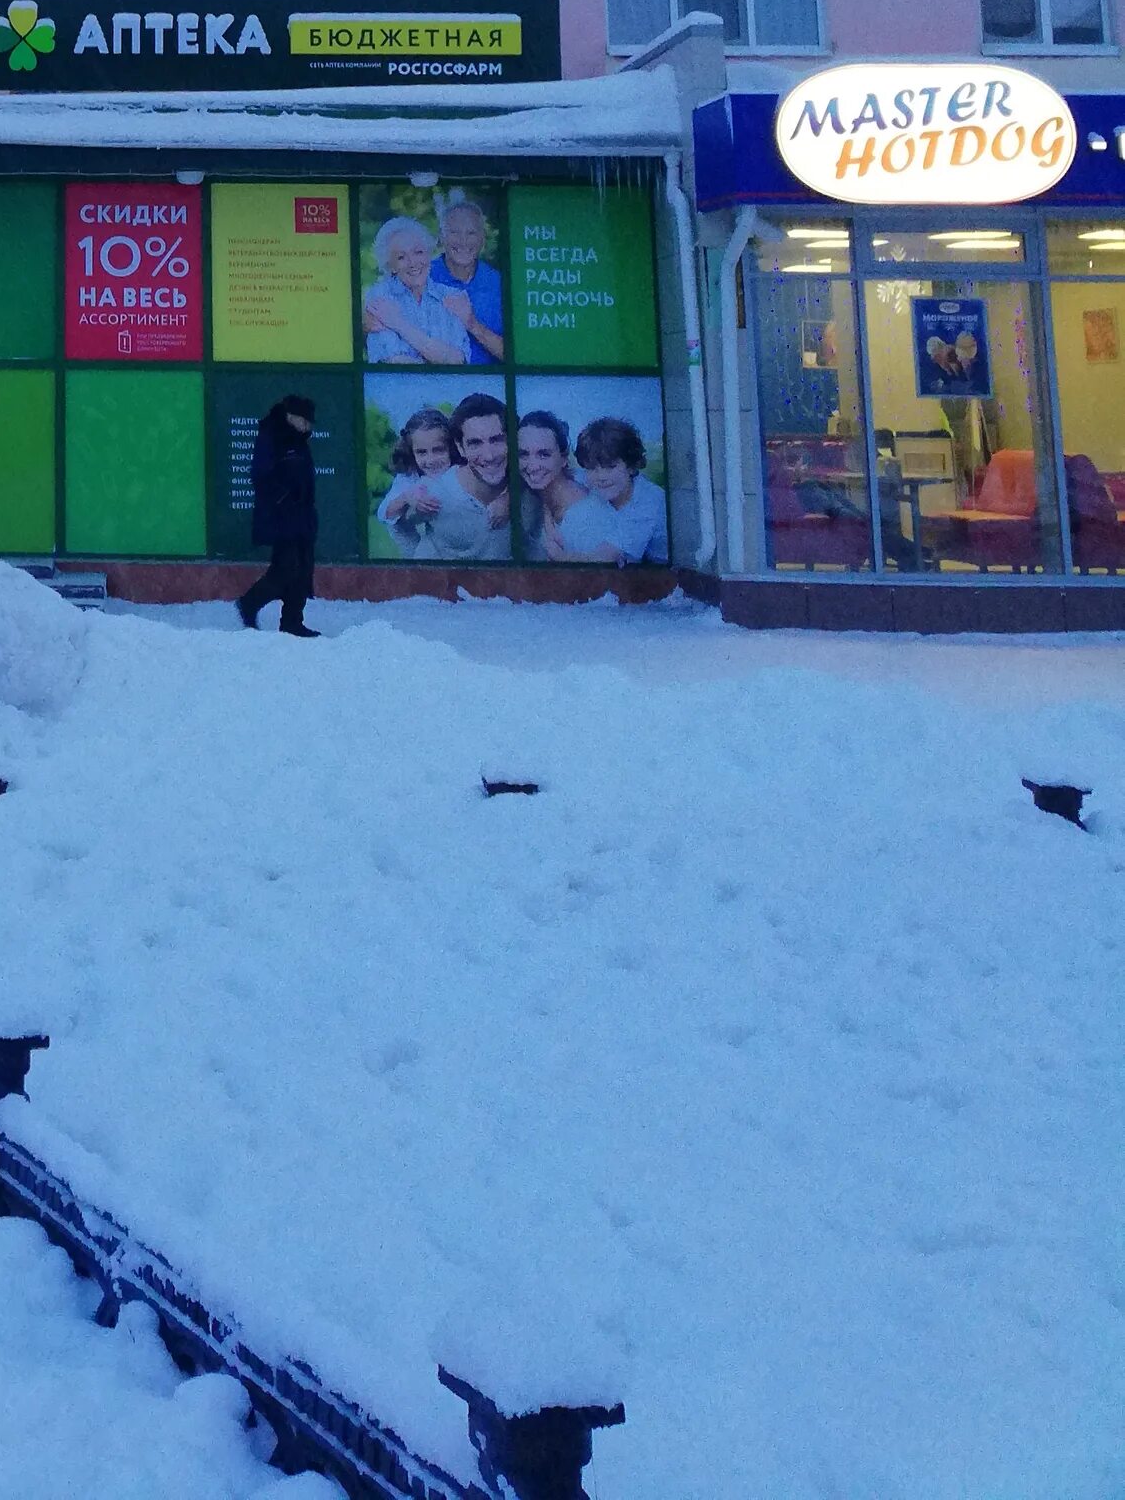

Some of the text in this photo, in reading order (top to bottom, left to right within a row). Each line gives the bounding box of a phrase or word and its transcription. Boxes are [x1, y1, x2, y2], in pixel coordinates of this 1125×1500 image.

[74, 12, 272, 54] АПТЕКА
[309, 28, 503, 49] БЮДЖЕТНАЯ
[388, 62, 502, 76] РОСГОСФАРМ
[789, 80, 1013, 141] MASTER
[834, 116, 1066, 180] HOTDOG
[79, 204, 187, 226] СКИДКИ
[302, 204, 331, 216] 10%
[524, 225, 557, 241] МЫ
[77, 235, 190, 278] 10%
[525, 246, 599, 265] ВСЕГДА
[526, 268, 582, 287] РАДЫ
[79, 286, 188, 308] НА ВЕСЬ
[527, 290, 615, 307] ПОМОЧЬ
[78, 313, 188, 326] АССОРТИМЕНТ
[528, 312, 576, 329] ВАМ!
[231, 417, 259, 425] МЕДТЕХ
[310, 430, 330, 438] ЛЬКИ
[231, 441, 255, 449] ПОДУ
[231, 453, 254, 461] КОРСЕ
[231, 465, 335, 475] ТРОС УНКИ
[231, 489, 256, 497] ВИТАМ
[231, 501, 255, 510] ВЕТЕР
